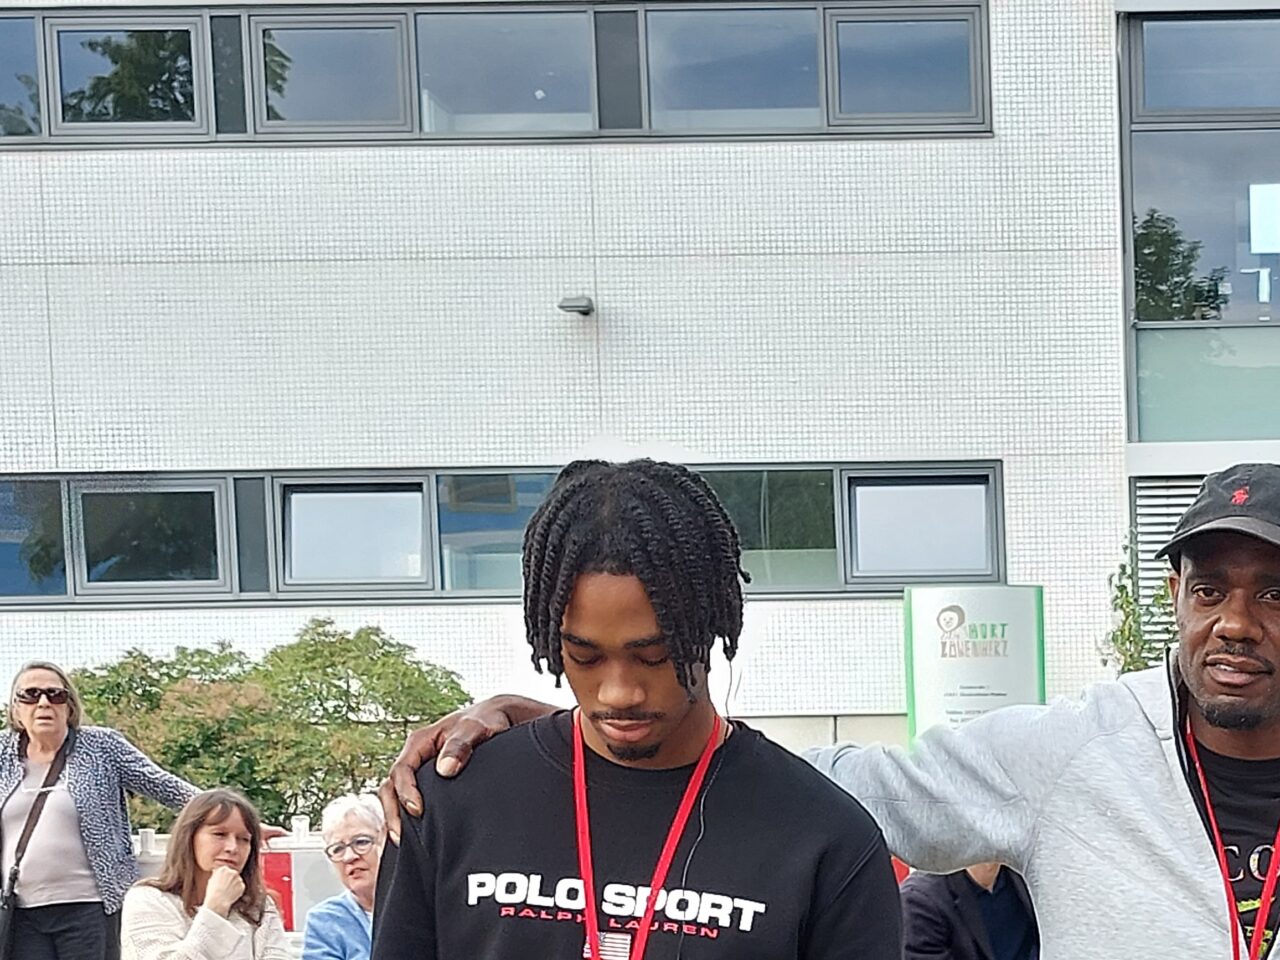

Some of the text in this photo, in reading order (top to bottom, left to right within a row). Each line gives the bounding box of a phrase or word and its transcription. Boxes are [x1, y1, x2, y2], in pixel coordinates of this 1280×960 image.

[968, 622, 1008, 639] HORT
[467, 872, 767, 932] POLO SPORT
